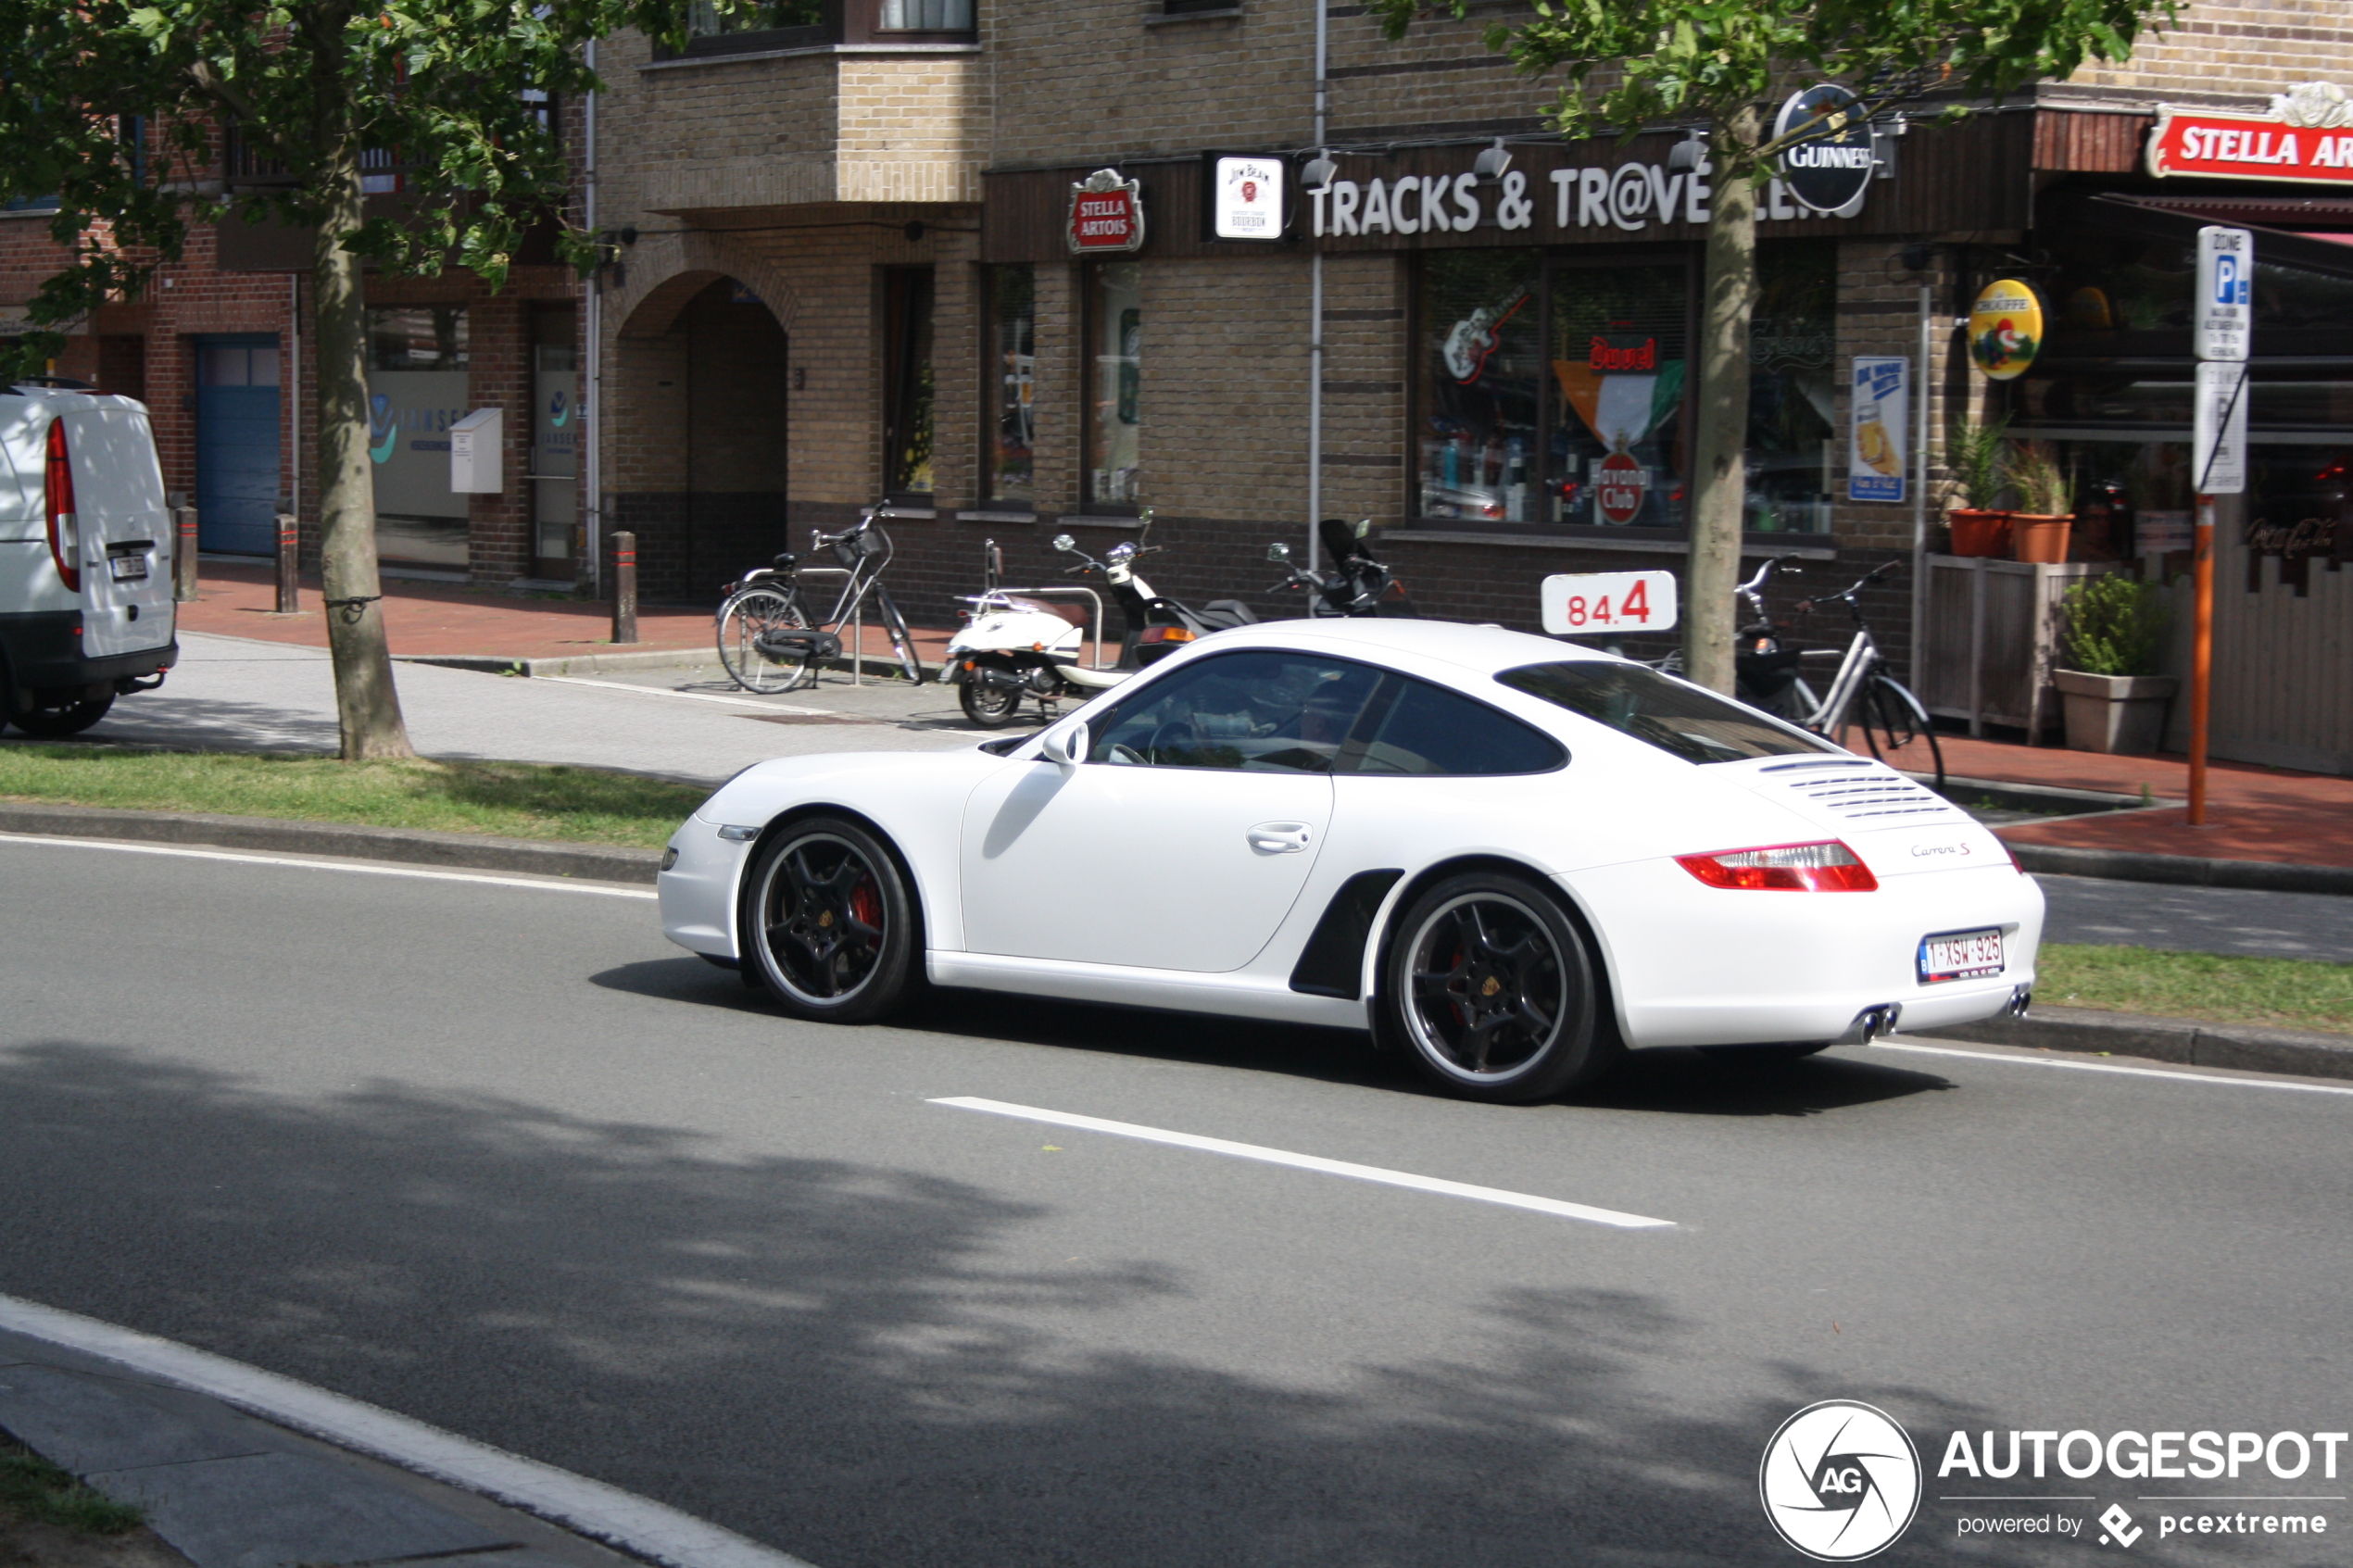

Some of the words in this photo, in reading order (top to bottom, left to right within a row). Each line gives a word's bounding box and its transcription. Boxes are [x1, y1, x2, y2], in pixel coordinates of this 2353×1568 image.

[2180, 126, 2299, 165] STELLA
[1788, 144, 1870, 169] GUINNESS
[1080, 200, 1126, 218] STELLA
[1307, 173, 1479, 237] TRACKS
[1497, 170, 1533, 231] &
[1080, 220, 1127, 236] ARTOIS
[2213, 233, 2241, 251] ZONE
[2218, 260, 2234, 298] P
[1589, 336, 1655, 370] Duvel
[1591, 470, 1647, 486] Havana
[1603, 488, 1635, 509] Club
[1567, 580, 1650, 626] 84.4
[1911, 845, 1956, 857] Carrera
[1959, 843, 1970, 856] S
[1921, 960, 1928, 972] B
